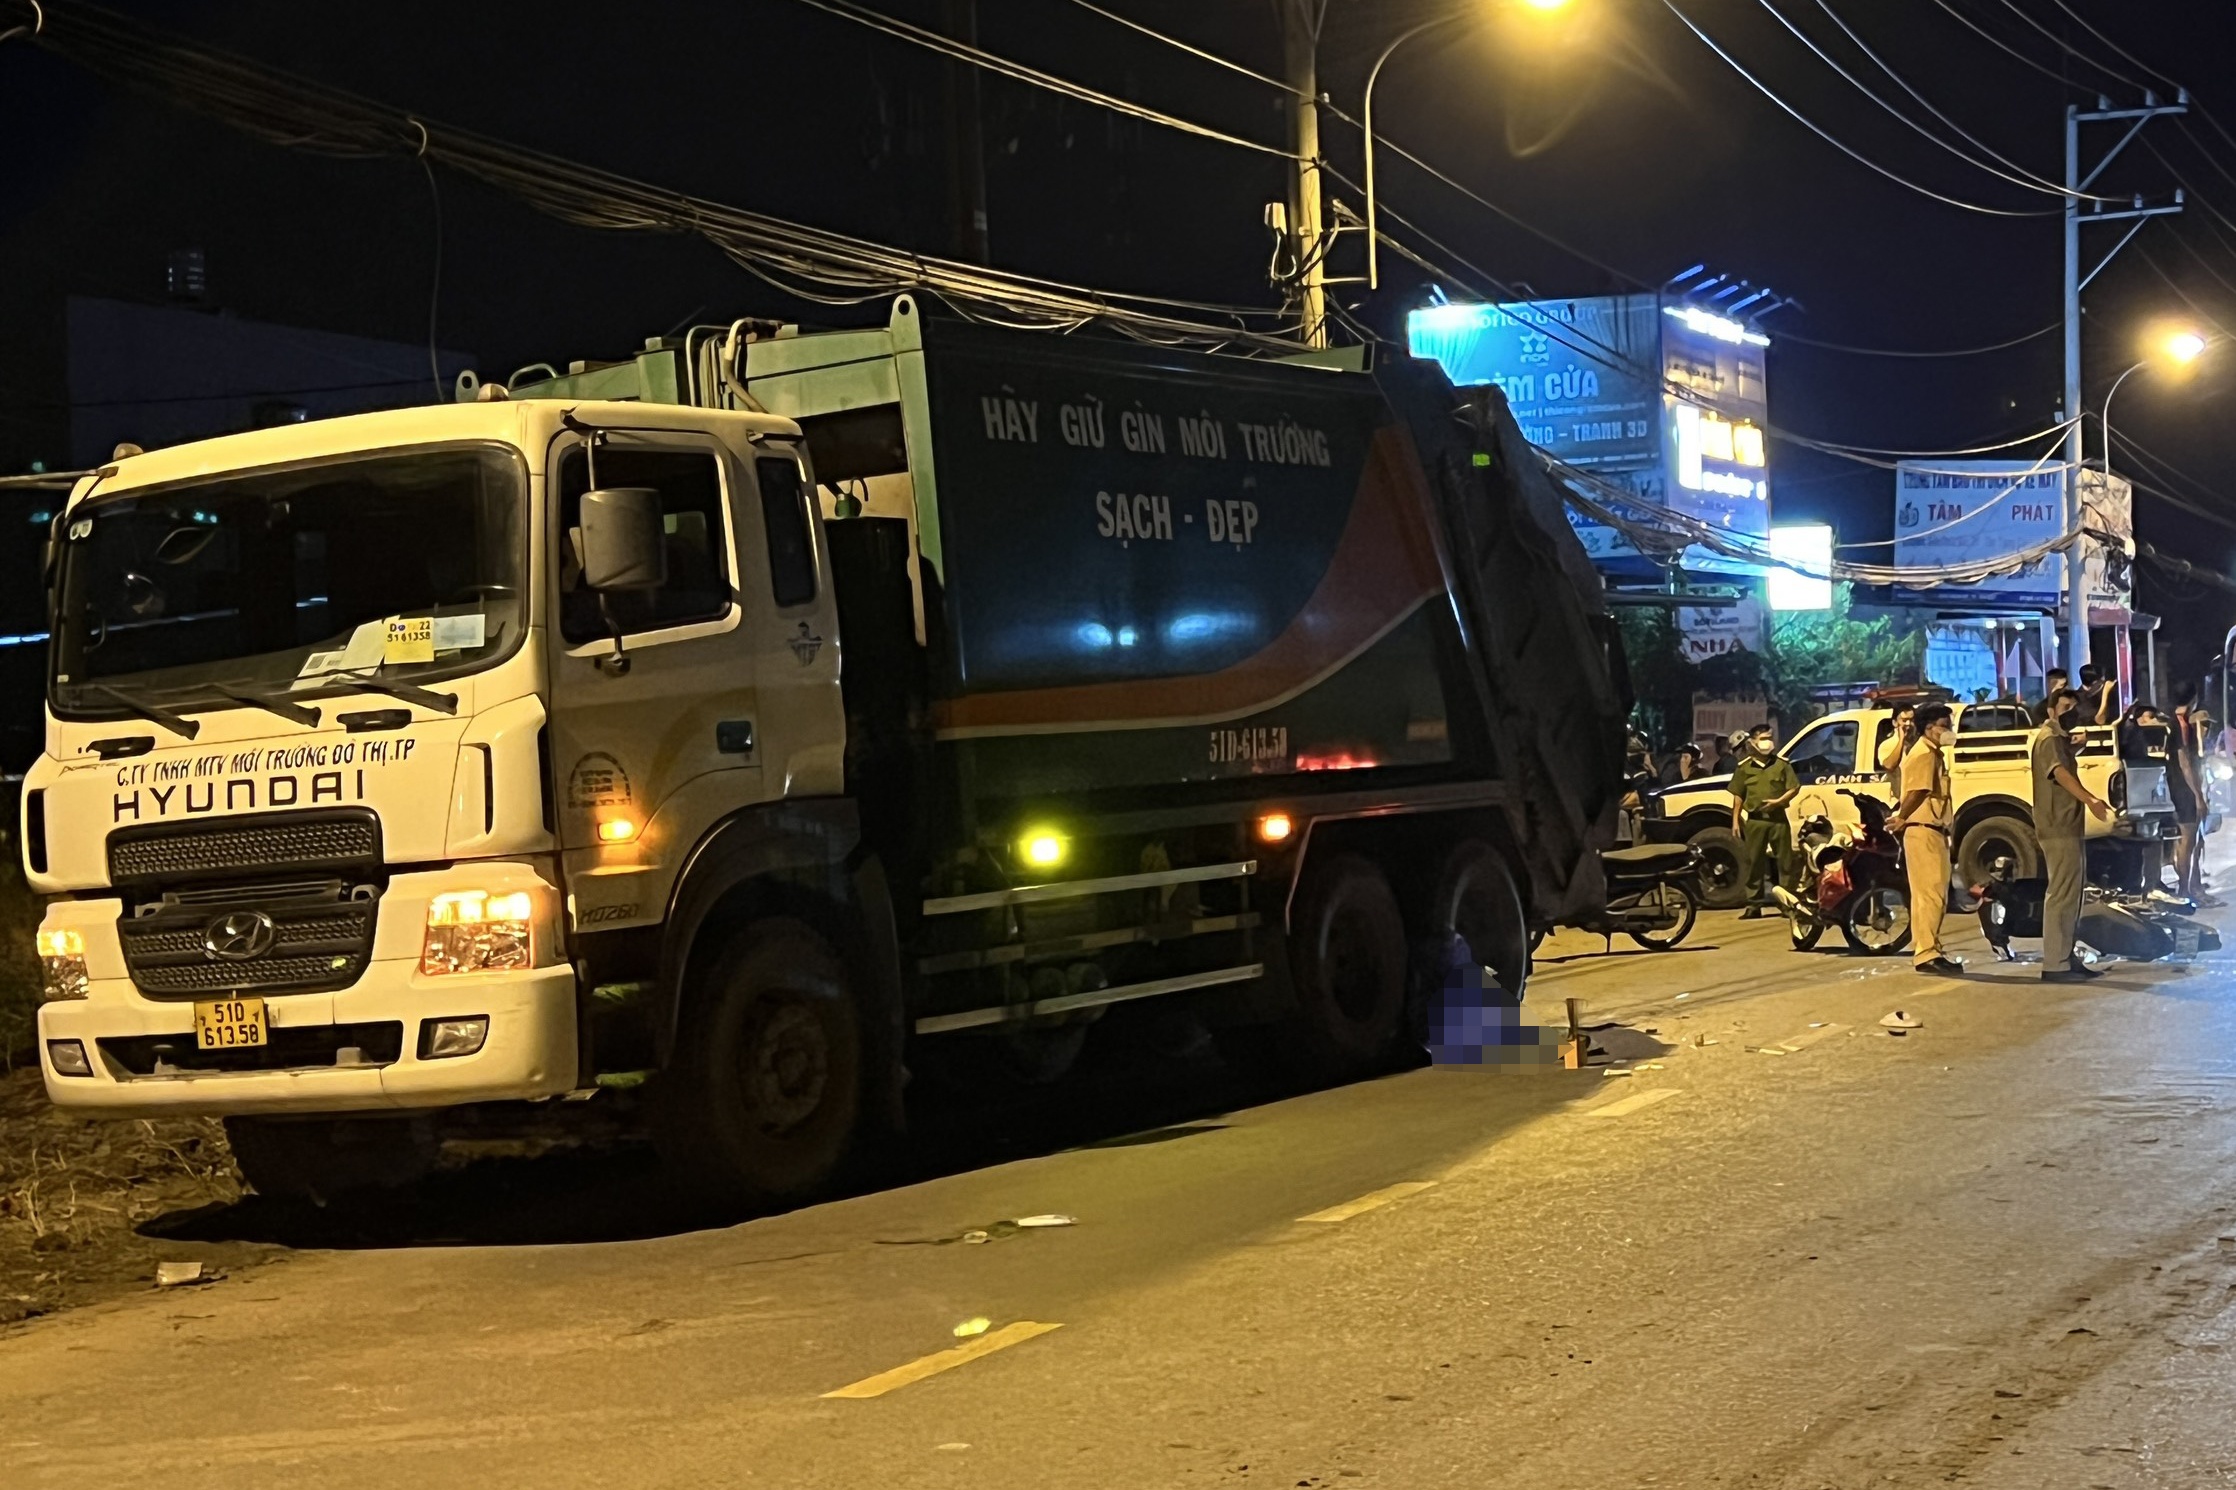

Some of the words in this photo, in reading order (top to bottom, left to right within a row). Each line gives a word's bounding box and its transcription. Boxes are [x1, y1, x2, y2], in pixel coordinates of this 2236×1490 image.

[1121, 399, 1167, 454] GÌN
[1178, 407, 1227, 460] MÔI
[1237, 411, 1332, 468] TRƯỜNG
[1572, 422, 1622, 442] TRANH
[1627, 420, 1648, 438] 3D
[1096, 490, 1173, 549] SẠCH
[1206, 498, 1259, 552] ĐẸP
[1928, 499, 1962, 521] TÂM
[154, 758, 193, 782] TNHH
[195, 754, 229, 777] MTV
[113, 769, 364, 822] HYUNDAI
[214, 1002, 245, 1023] 51D
[205, 1023, 259, 1046] 613.58
